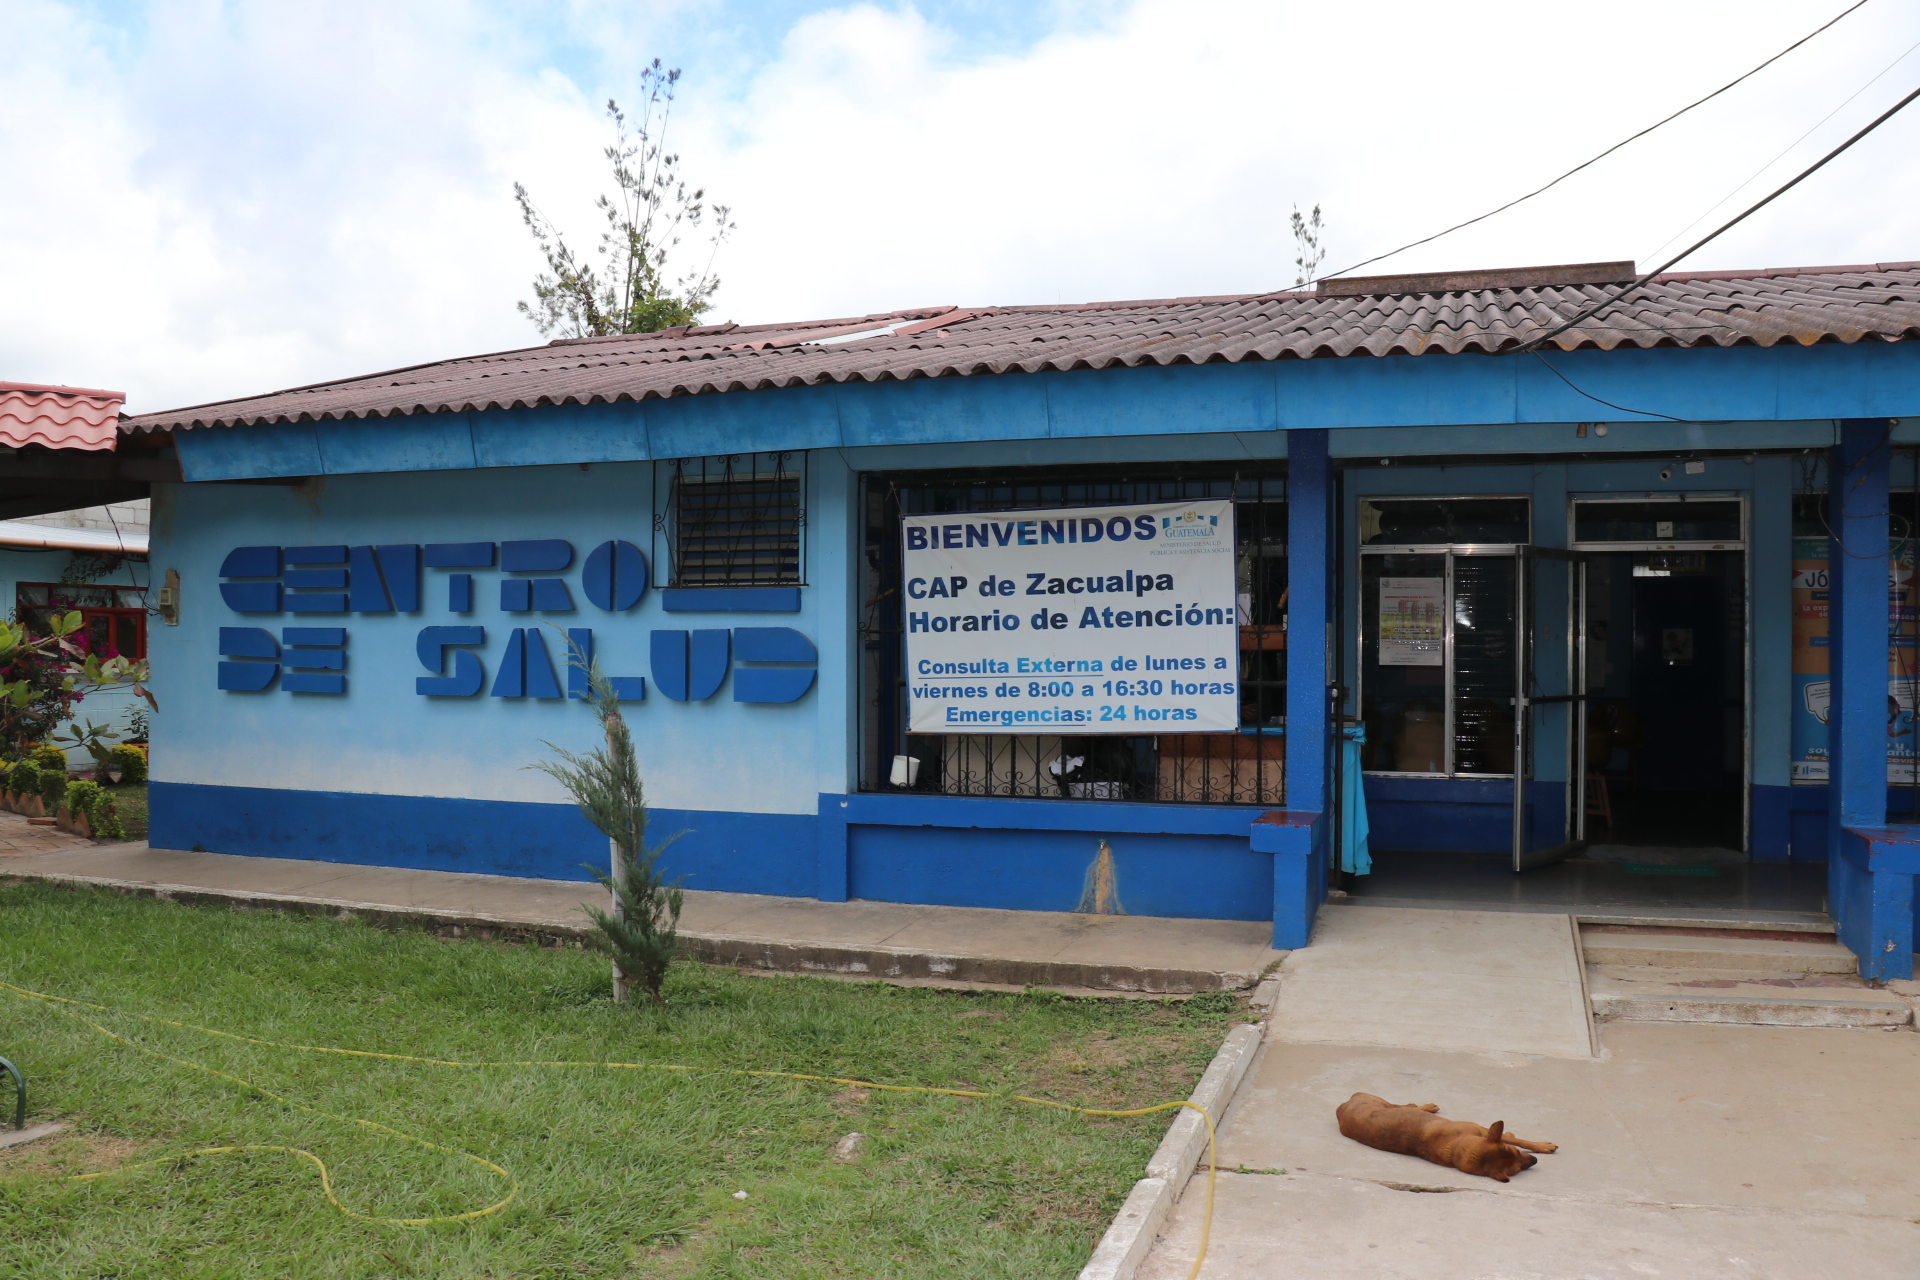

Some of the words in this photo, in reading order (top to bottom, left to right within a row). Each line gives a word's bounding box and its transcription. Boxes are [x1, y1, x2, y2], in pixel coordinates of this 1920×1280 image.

[907, 514, 1157, 551] BIENVENIDOS
[218, 539, 647, 613] CENTRO
[907, 576, 968, 599] CAP
[979, 575, 1016, 597] de
[1026, 570, 1174, 597] Zacualpa
[909, 609, 1020, 633] Horario
[1031, 608, 1069, 630] de
[1079, 603, 1235, 629] Atención:
[218, 626, 347, 694] DE
[416, 625, 819, 703] SALUD
[918, 659, 1009, 675] Consulta
[1017, 658, 1103, 673] Externa
[1111, 656, 1138, 672] de
[1145, 655, 1207, 671] lunes
[1214, 657, 1227, 670] a
[912, 683, 988, 699] viernes
[995, 682, 1021, 698] de
[1028, 681, 1074, 698] 8:00
[1082, 684, 1095, 697] a
[1103, 679, 1163, 696] 16:30
[1171, 679, 1235, 695] horas
[946, 706, 1093, 725] Emergencias:
[1100, 705, 1127, 722] 24
[1134, 704, 1198, 721] horas
